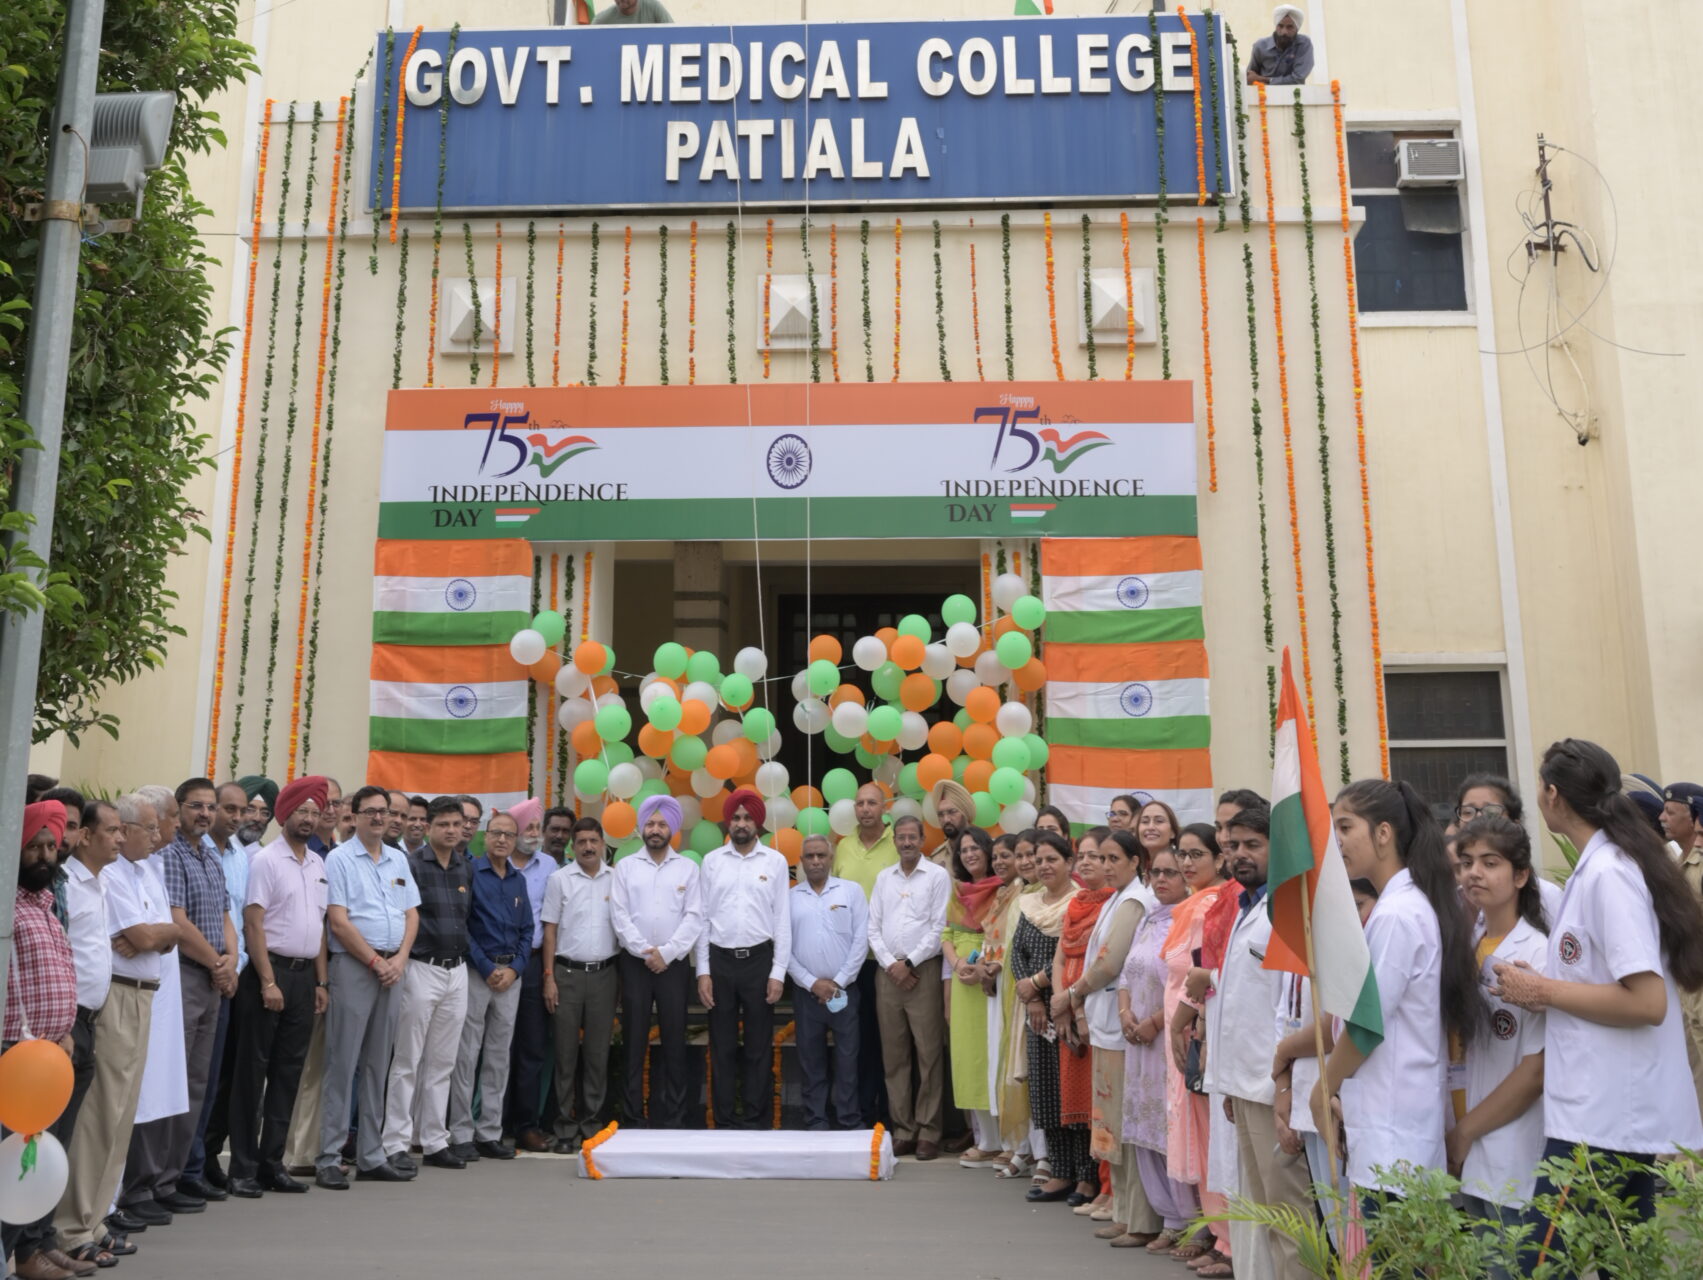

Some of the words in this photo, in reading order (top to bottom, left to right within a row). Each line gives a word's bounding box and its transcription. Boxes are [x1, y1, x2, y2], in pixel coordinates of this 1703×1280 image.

[404, 46, 593, 107] GOVT.
[619, 38, 889, 103] MEDICAL
[916, 31, 1196, 96] COLLEGE
[665, 117, 931, 181] PATIALA
[428, 480, 629, 506] INDEPENDENCE
[941, 477, 1145, 501] INDEPENDENCE
[431, 508, 482, 528] DAY
[945, 503, 998, 522] DAY
